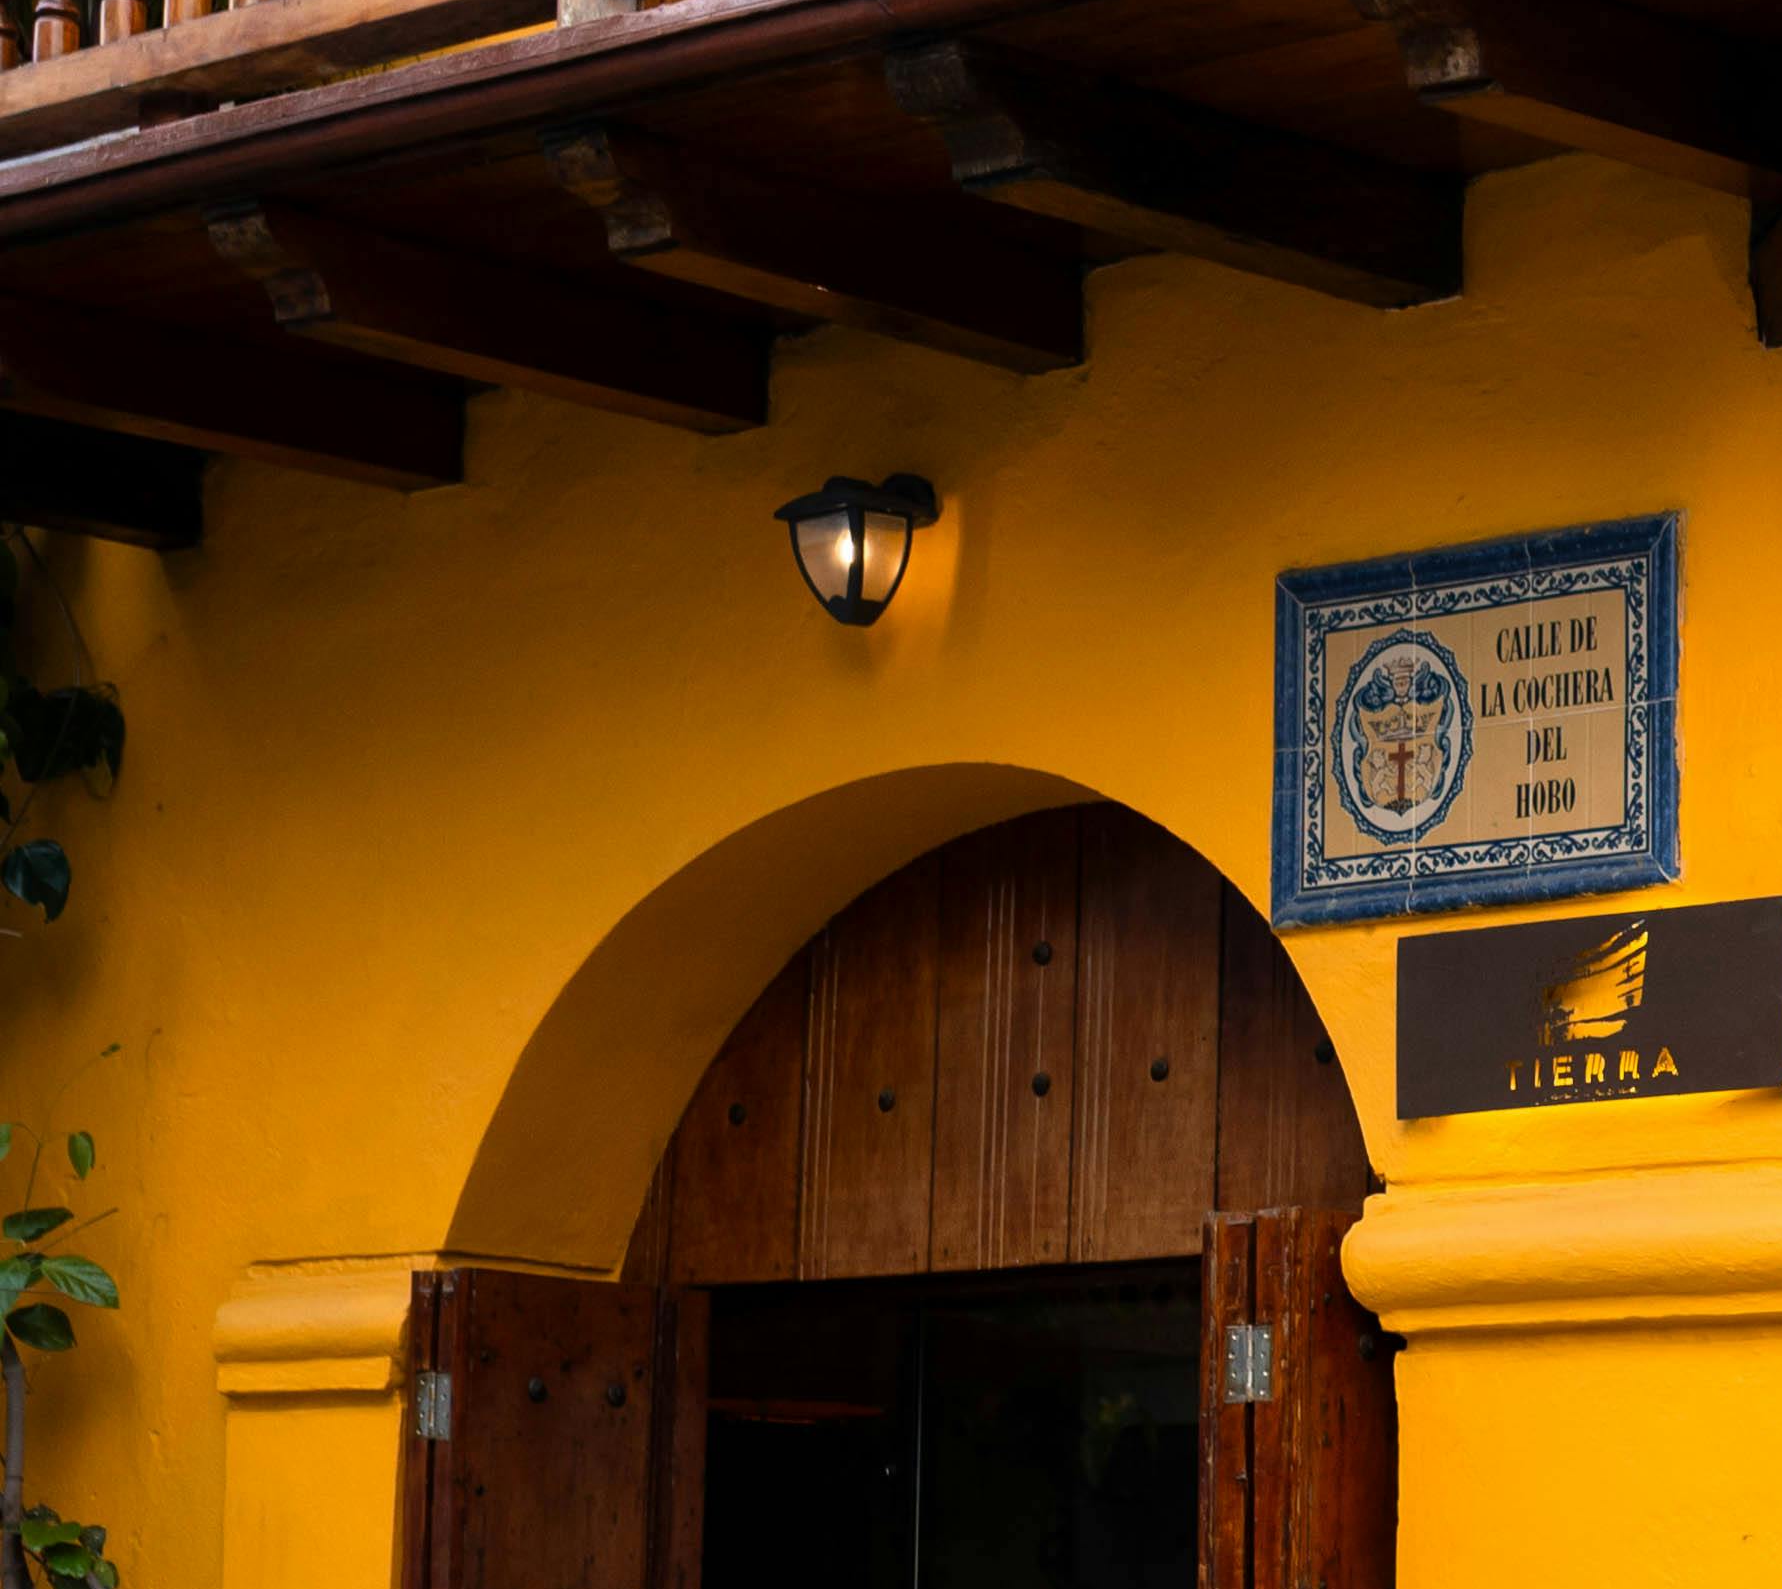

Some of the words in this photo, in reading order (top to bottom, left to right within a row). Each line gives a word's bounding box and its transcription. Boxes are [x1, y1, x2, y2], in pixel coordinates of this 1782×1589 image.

[1496, 620, 1562, 664] CALLE
[1569, 616, 1598, 653] DE
[1480, 679, 1506, 718] LA
[1512, 667, 1614, 712] COCHERA
[1526, 725, 1567, 765] DEL
[1515, 776, 1576, 819] HOBO
[1505, 1047, 1679, 1091] TIERRA
